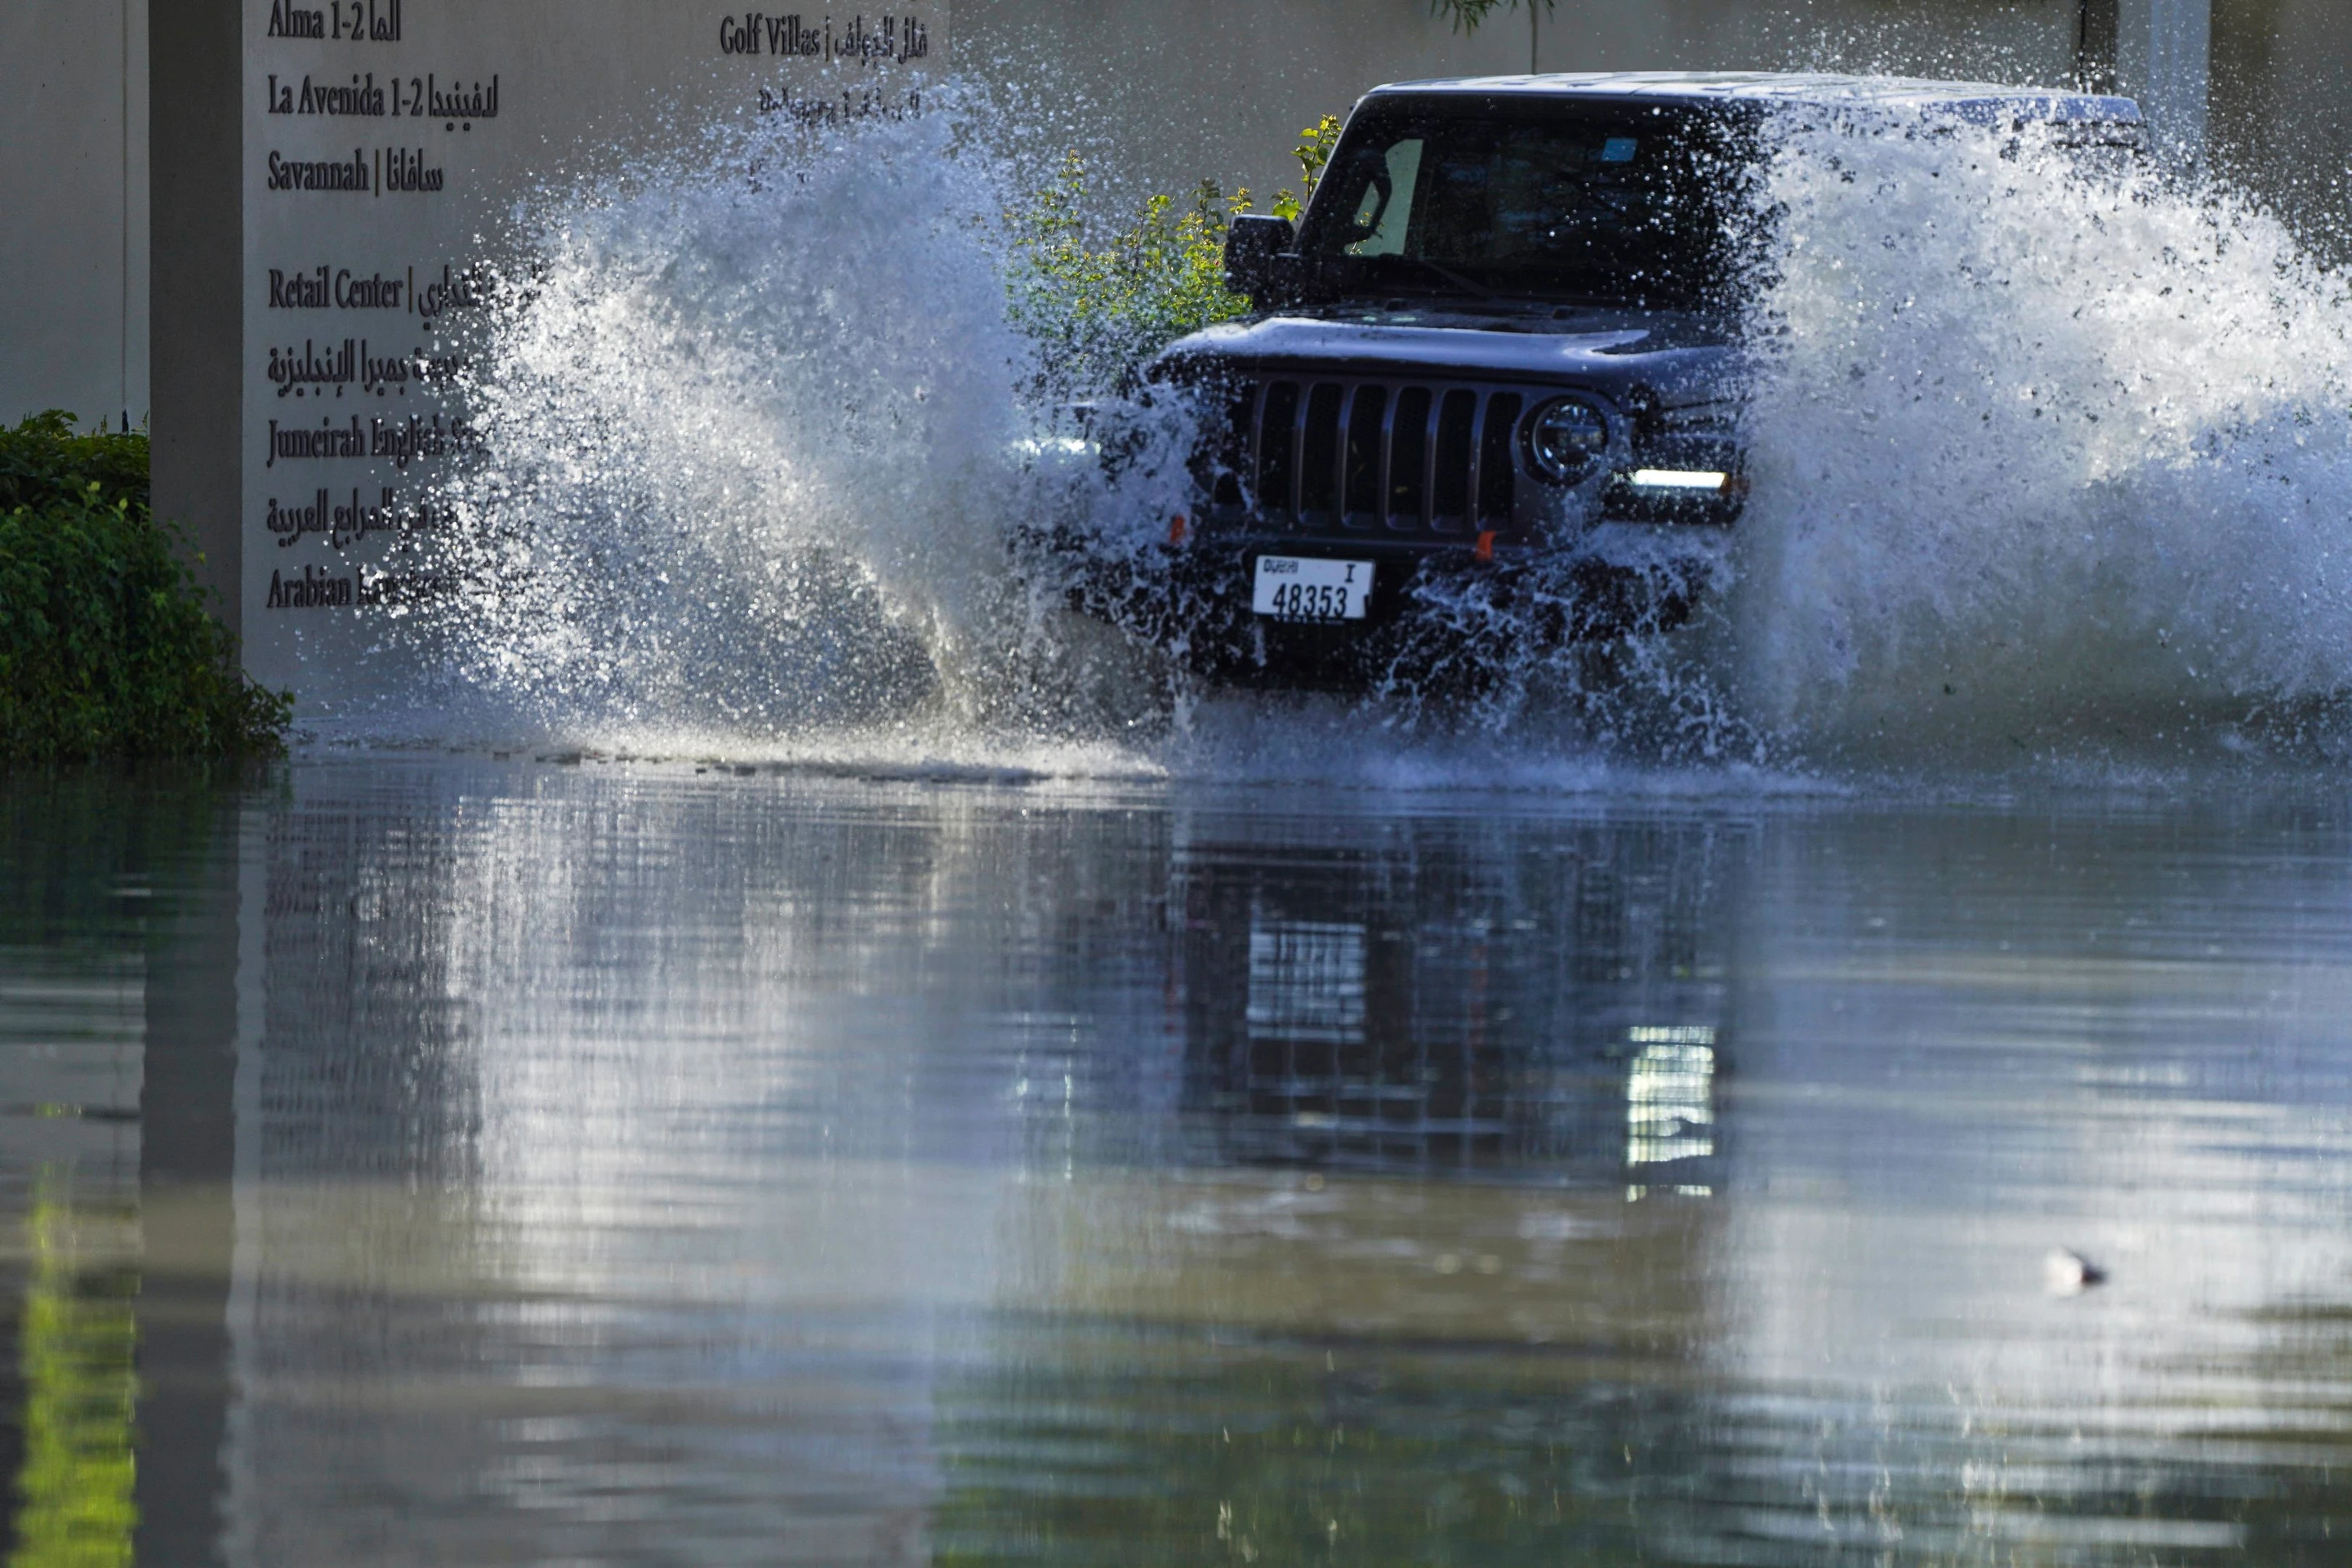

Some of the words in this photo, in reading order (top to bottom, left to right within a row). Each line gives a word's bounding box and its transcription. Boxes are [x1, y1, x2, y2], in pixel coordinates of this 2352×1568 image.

[268, 0, 325, 38] Alma
[331, 0, 364, 40] 1-2
[720, 13, 763, 55] Golf
[765, 15, 821, 56] Villas
[268, 74, 293, 114] La
[298, 73, 385, 116] Avenida
[391, 77, 423, 116] 1-2
[268, 148, 369, 191] Savannah
[387, 147, 443, 191] سافانا
[269, 265, 331, 309] Retail
[336, 269, 403, 309] Center
[266, 414, 366, 468] Jumeirah
[371, 414, 446, 469] English
[266, 564, 353, 608] Arabian
[1344, 564, 1356, 583] I
[1272, 582, 1348, 618] 48353
